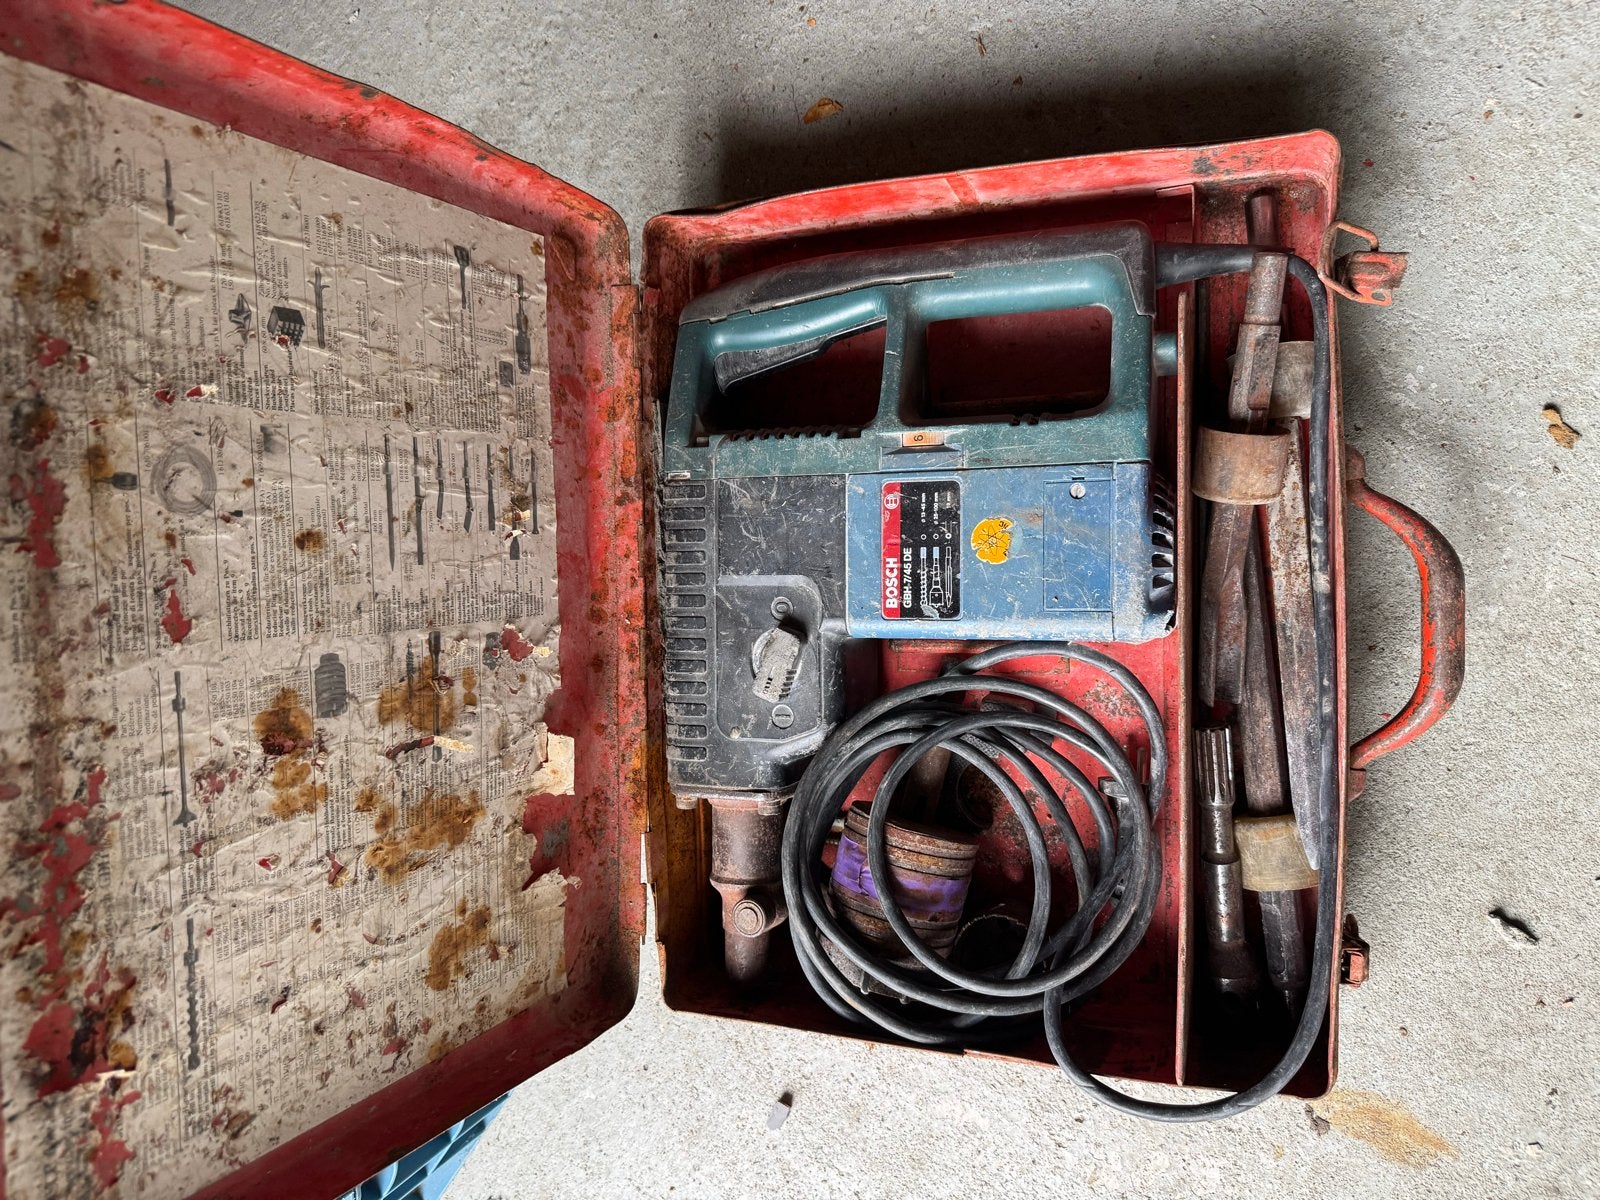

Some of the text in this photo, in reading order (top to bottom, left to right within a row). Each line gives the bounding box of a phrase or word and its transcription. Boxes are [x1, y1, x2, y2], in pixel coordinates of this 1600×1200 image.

[885, 558, 898, 608] BOSCH
[904, 547, 912, 608] GBH 7/45 DE
